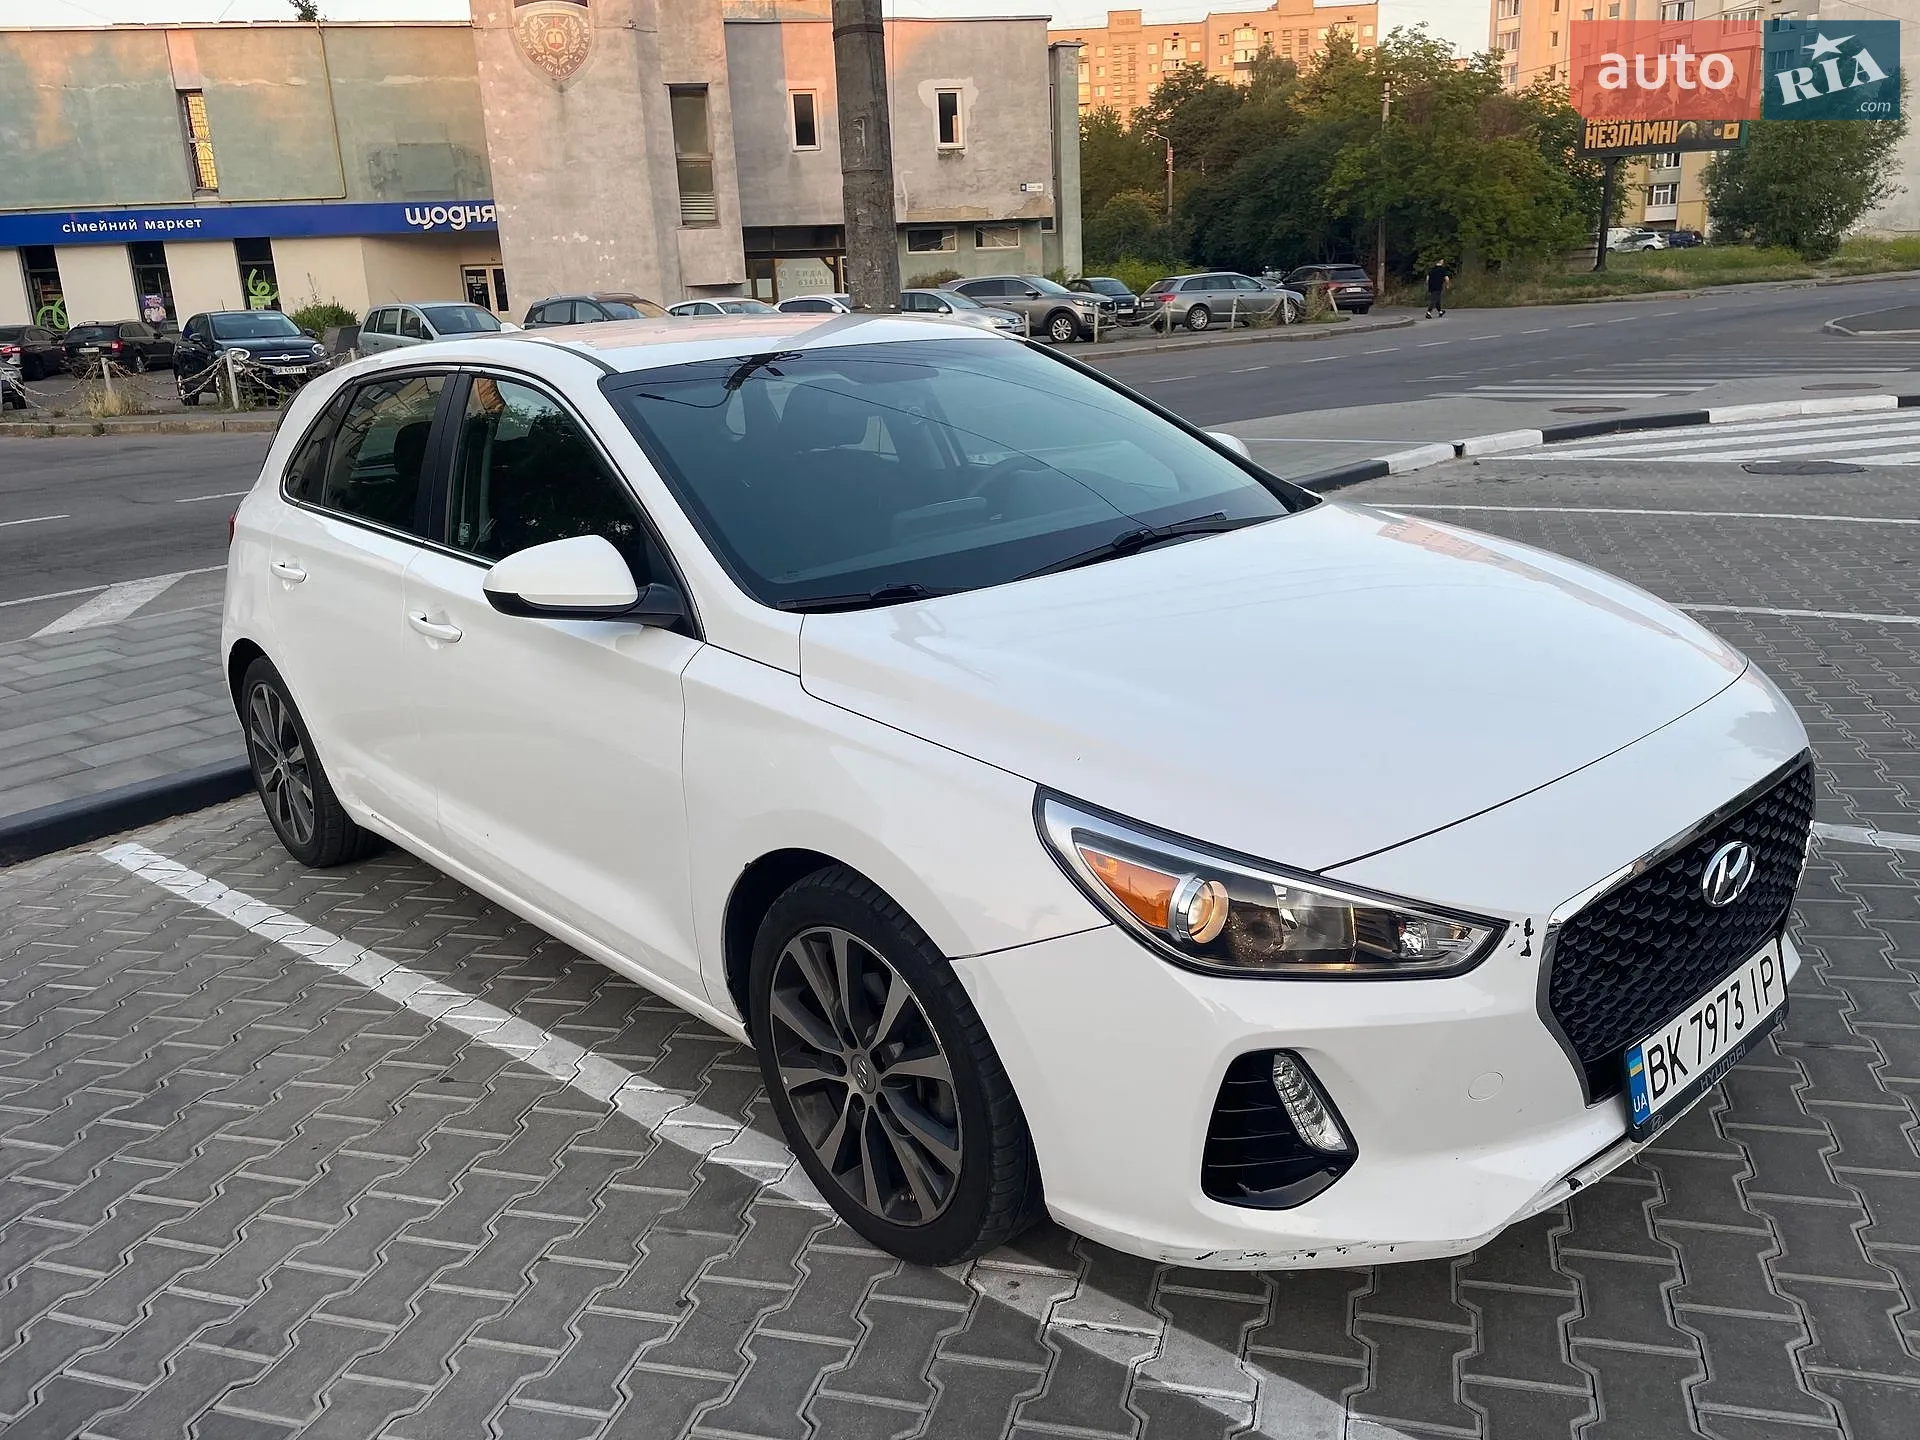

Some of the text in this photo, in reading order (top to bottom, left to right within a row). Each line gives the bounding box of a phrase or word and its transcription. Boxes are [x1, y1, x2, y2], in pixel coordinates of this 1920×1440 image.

[1584, 120, 1679, 149] НЕЗЛАМНІ
[62, 218, 202, 233] сімейний маркет
[1647, 955, 1774, 1101] BK 7973 IP
[1700, 1043, 1747, 1092] HYUNDAI
[1633, 1092, 1648, 1113] UA
